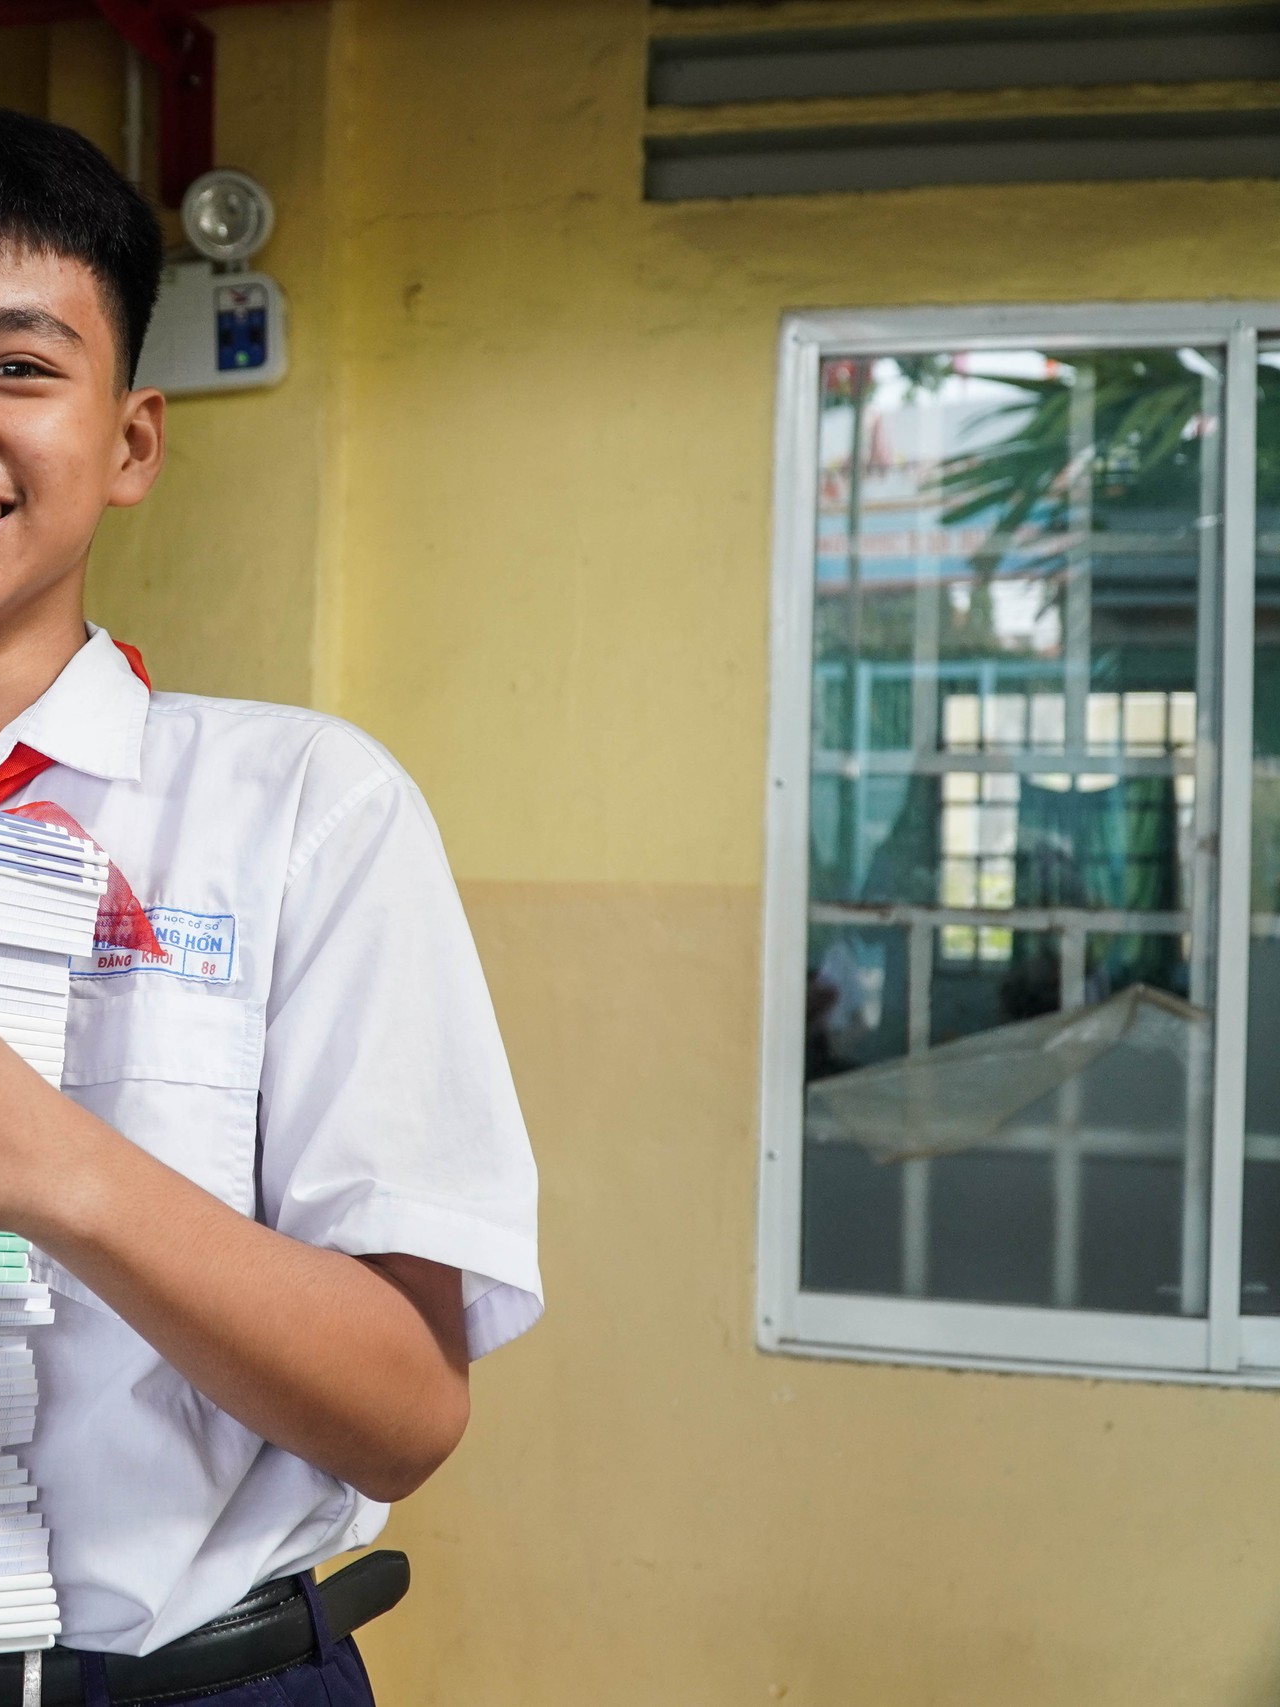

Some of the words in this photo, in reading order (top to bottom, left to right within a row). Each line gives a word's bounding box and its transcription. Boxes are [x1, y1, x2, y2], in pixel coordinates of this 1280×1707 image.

[164, 915, 185, 925] HỌC
[188, 920, 202, 929] CƠ
[204, 919, 222, 931] SỞ
[155, 927, 181, 945] NG
[185, 932, 223, 952] HỚN
[97, 953, 132, 968] ĐĂNG
[201, 961, 216, 975] 88
